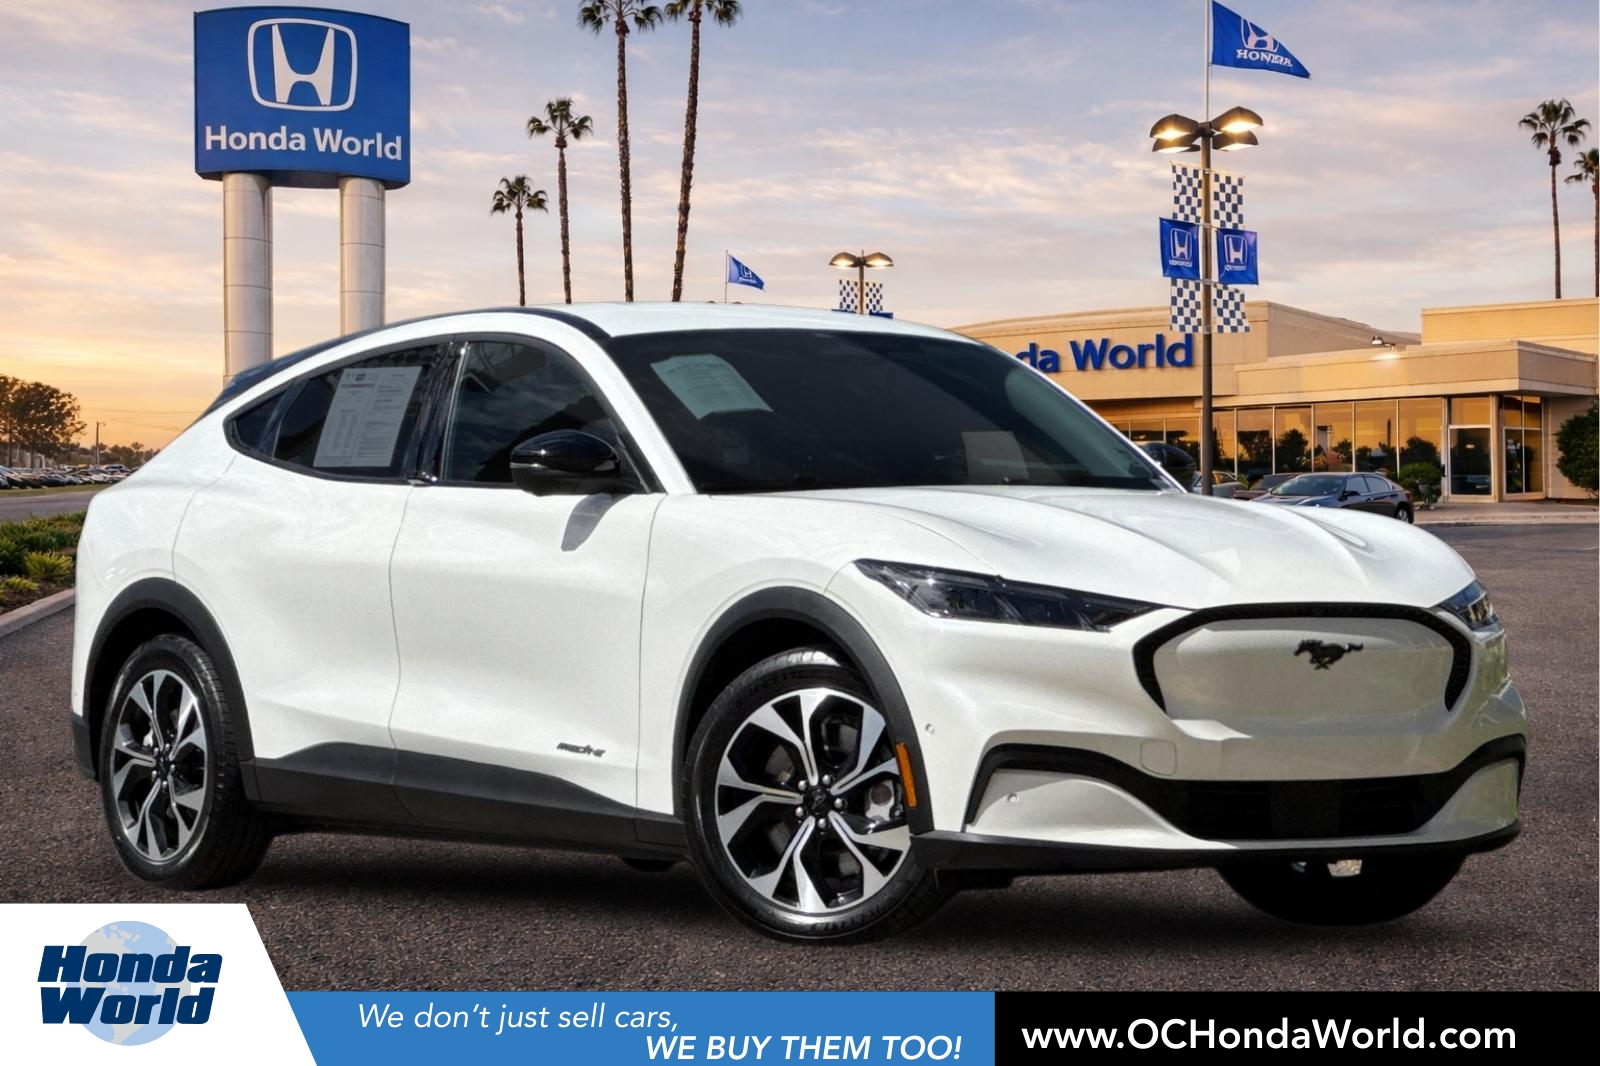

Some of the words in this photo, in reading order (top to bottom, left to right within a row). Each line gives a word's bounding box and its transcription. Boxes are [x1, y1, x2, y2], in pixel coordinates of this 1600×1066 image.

[205, 125, 306, 151] Honda
[313, 127, 402, 161] World
[1069, 333, 1194, 371] World
